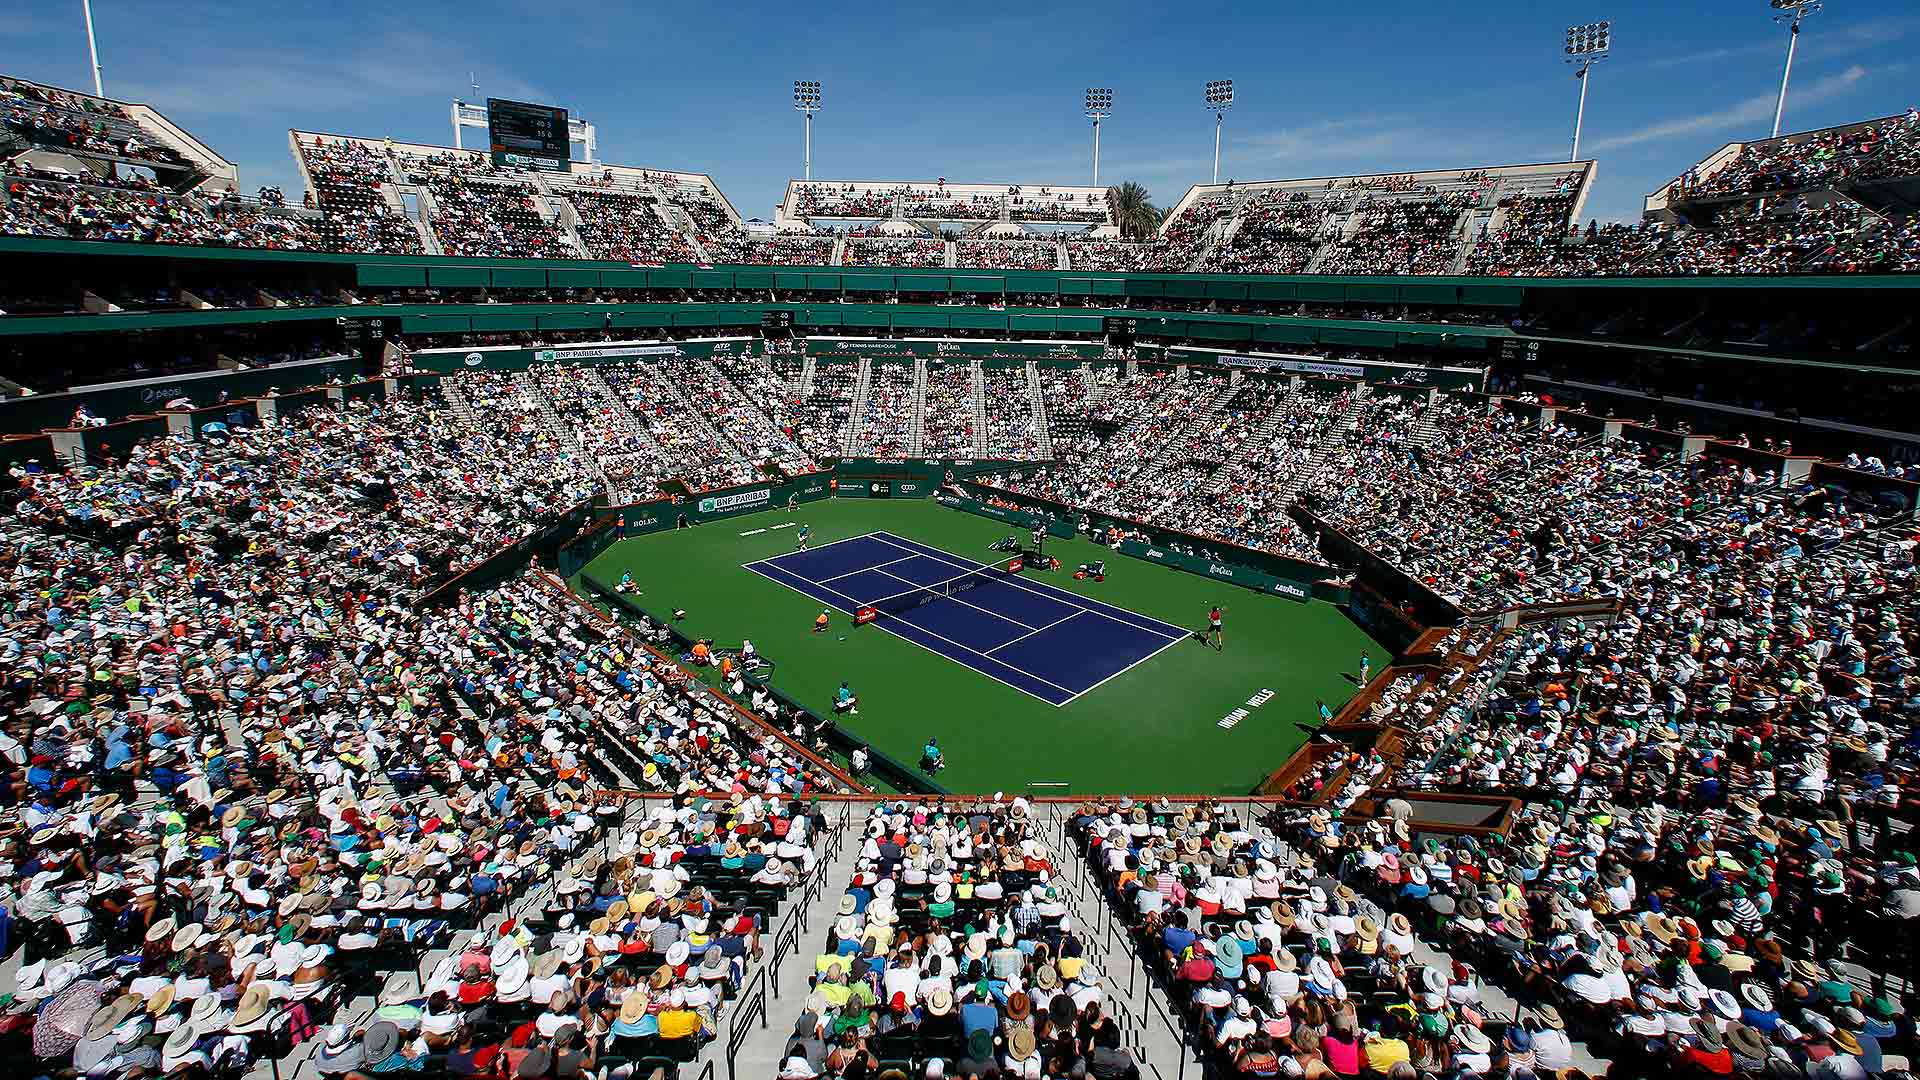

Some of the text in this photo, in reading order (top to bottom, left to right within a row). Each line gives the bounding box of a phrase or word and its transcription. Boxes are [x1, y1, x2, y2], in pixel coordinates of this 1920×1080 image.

[370, 319, 382, 327] 40
[1527, 342, 1539, 350] 40
[555, 349, 603, 358] BNP PARIBAS
[1526, 352, 1537, 361] 15
[156, 386, 182, 399] pepsi
[716, 491, 768, 506] BNP PARIBAS
[633, 517, 658, 527] ROLEX
[1245, 688, 1276, 708] WELLS
